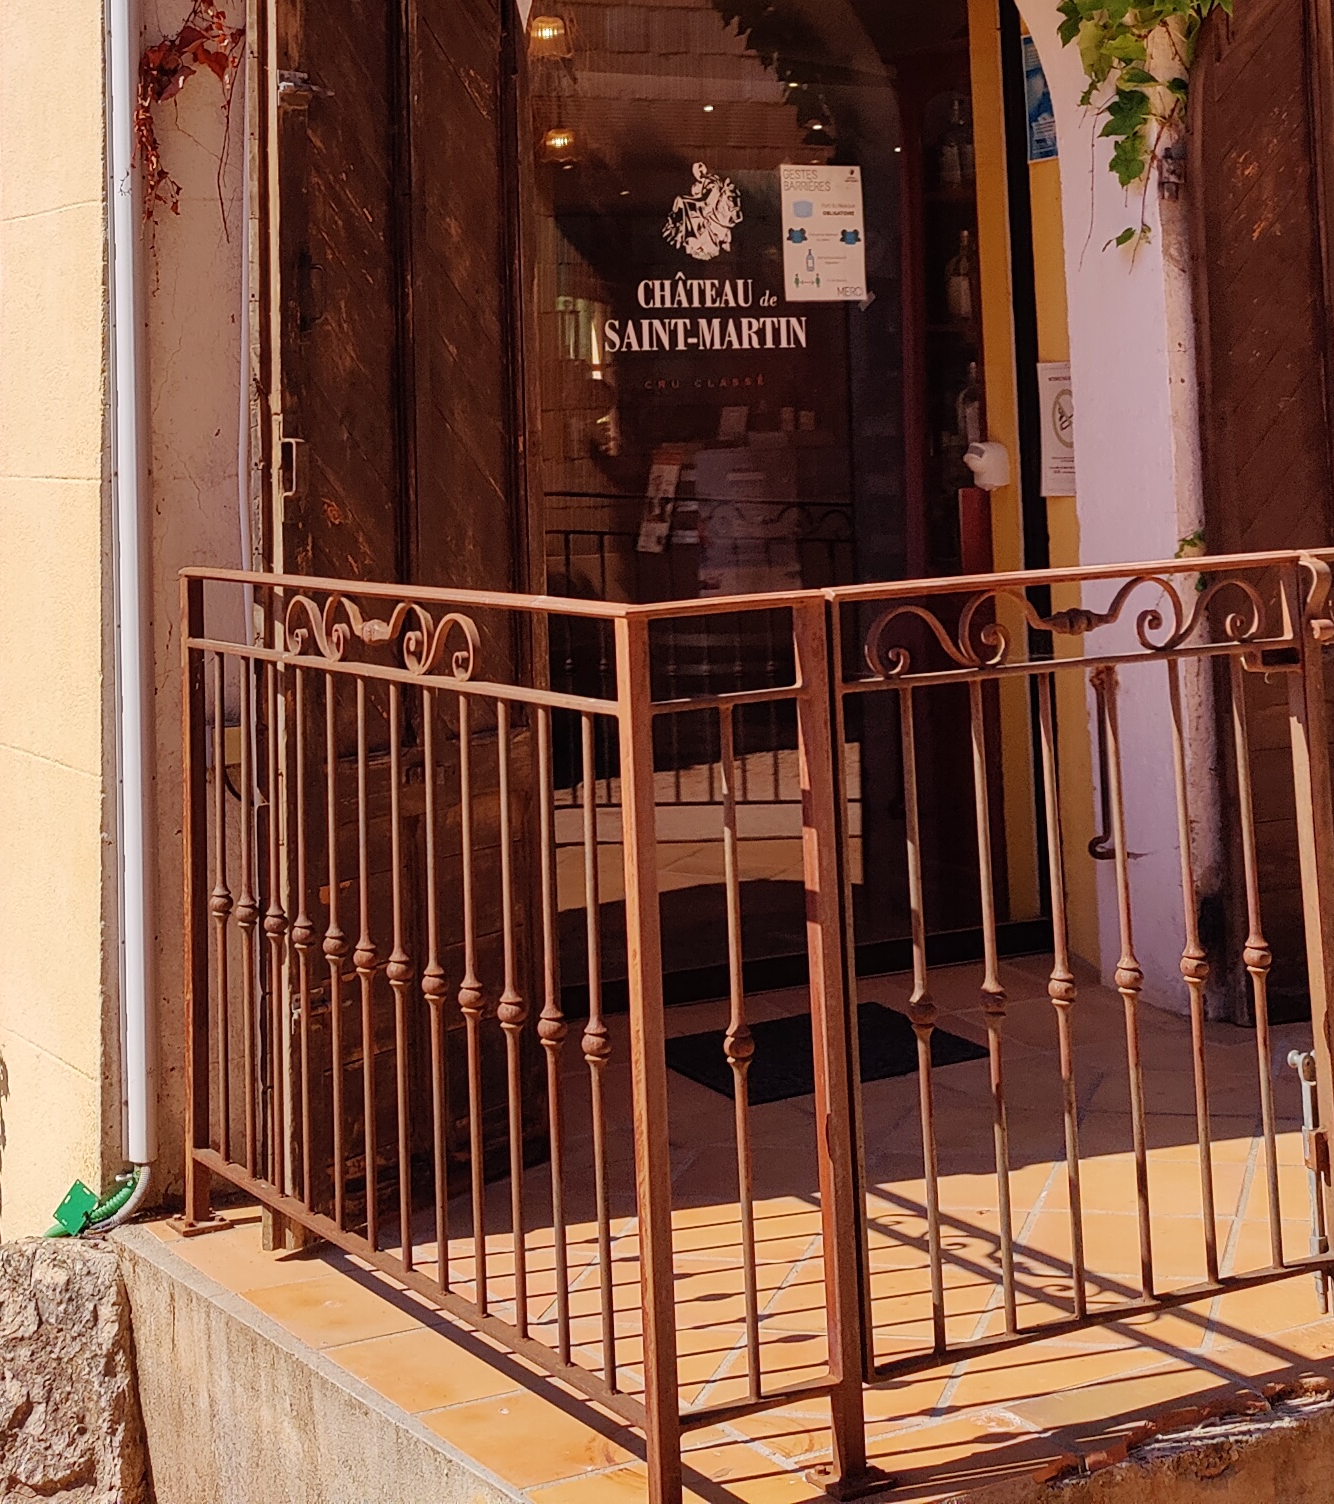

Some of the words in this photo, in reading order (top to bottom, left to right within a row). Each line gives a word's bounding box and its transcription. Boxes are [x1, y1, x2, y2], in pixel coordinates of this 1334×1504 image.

[782, 168, 819, 180] GESTES
[637, 271, 753, 309] CHÂTEAU
[759, 289, 778, 307] de
[604, 316, 807, 353] SAINT-MARTIN
[643, 379, 681, 390] CRU
[693, 373, 765, 389] CLASSÉ
